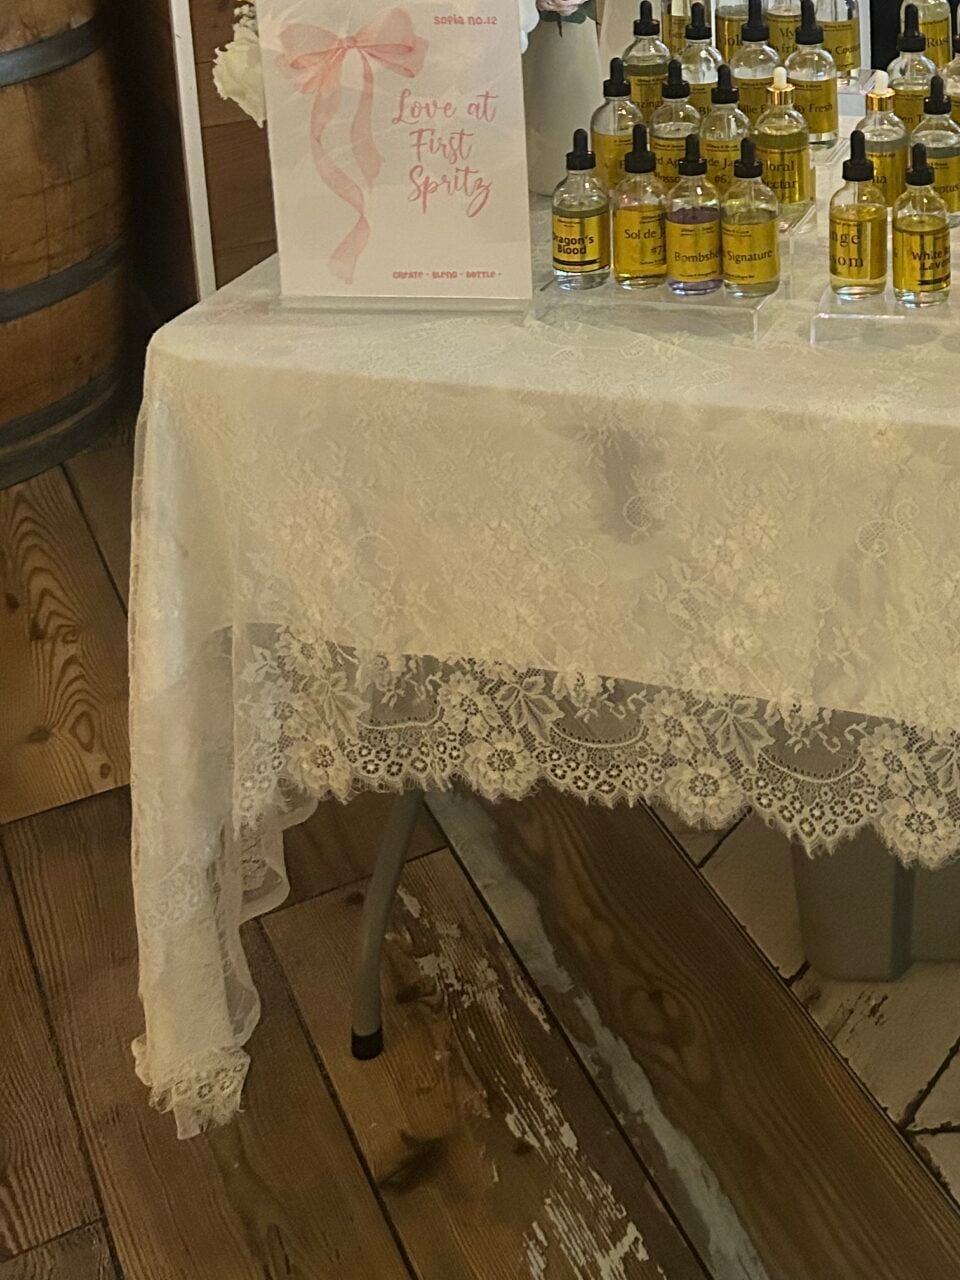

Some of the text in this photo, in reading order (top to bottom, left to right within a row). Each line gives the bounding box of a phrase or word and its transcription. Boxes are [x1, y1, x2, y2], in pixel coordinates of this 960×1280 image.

[392, 88, 499, 125] Love at
[809, 102, 833, 113] Fresh
[409, 128, 475, 163] First
[765, 160, 795, 172] loral
[408, 165, 492, 218] Spritz
[624, 228, 641, 240] Sol
[643, 229, 657, 240] de
[557, 244, 588, 255] Blood
[674, 250, 723, 264] Bombshe
[727, 249, 774, 265] Signature
